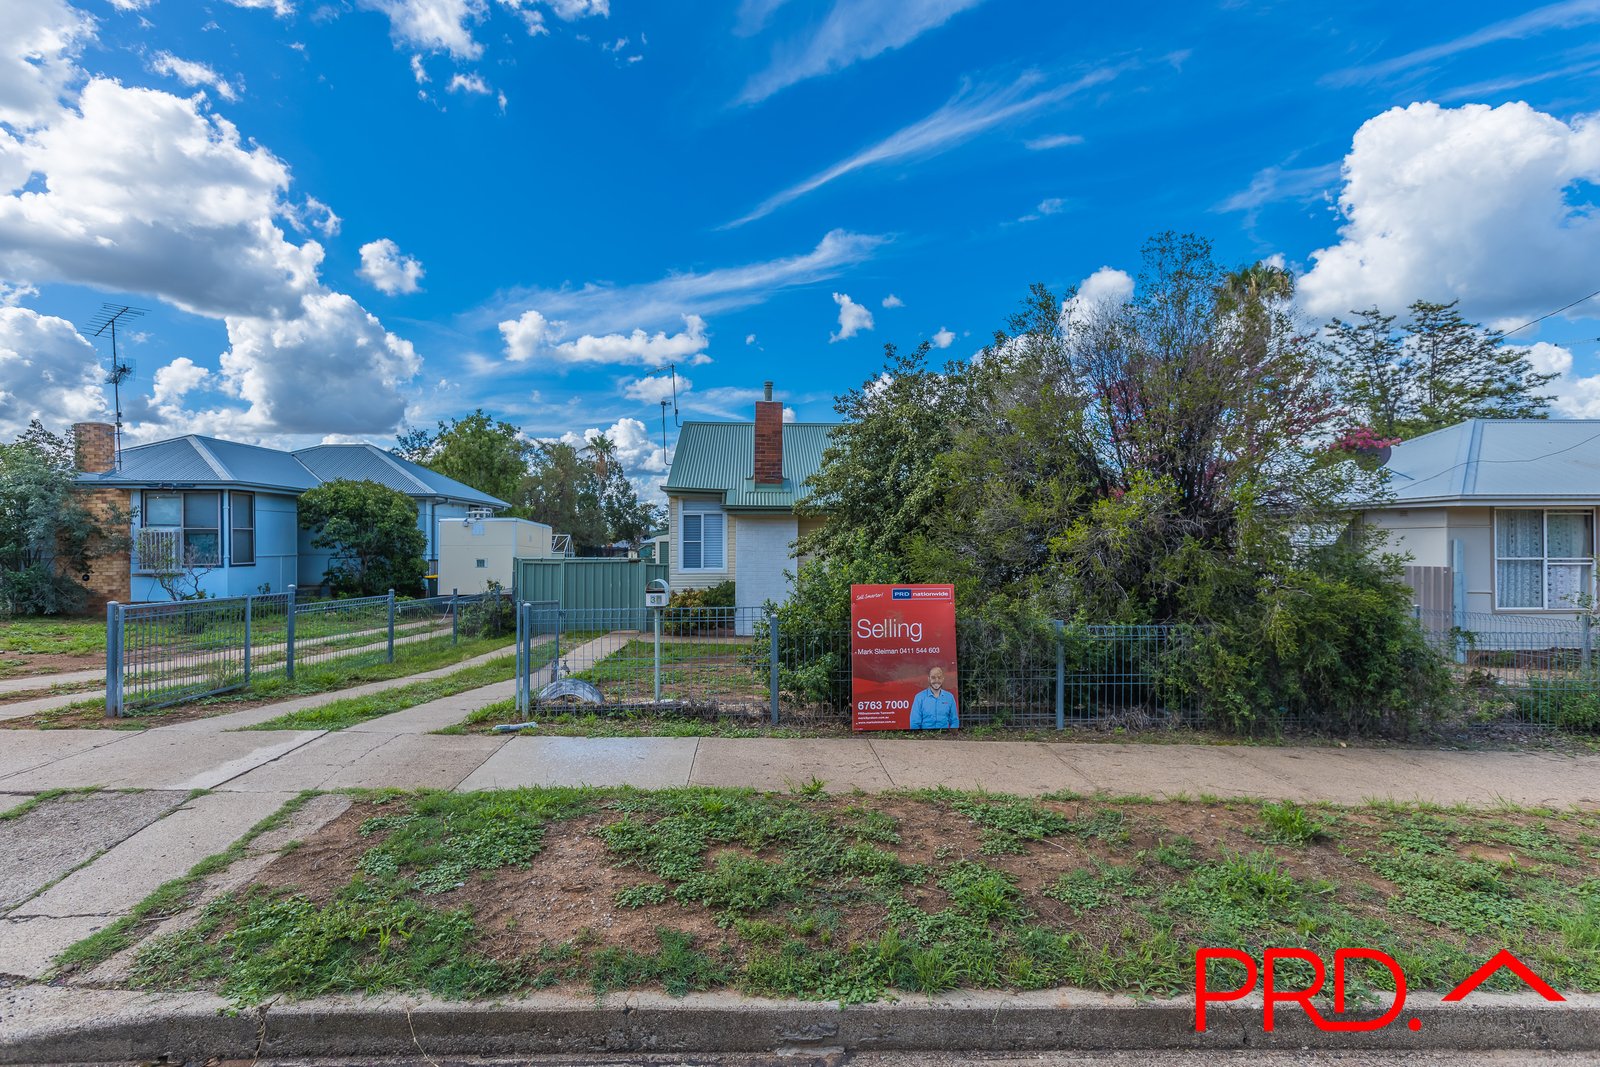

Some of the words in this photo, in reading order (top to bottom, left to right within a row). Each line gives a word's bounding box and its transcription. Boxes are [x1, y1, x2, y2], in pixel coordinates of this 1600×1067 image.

[857, 618, 923, 643] Selling
[857, 701, 883, 710] 6763
[885, 700, 910, 710] 7000
